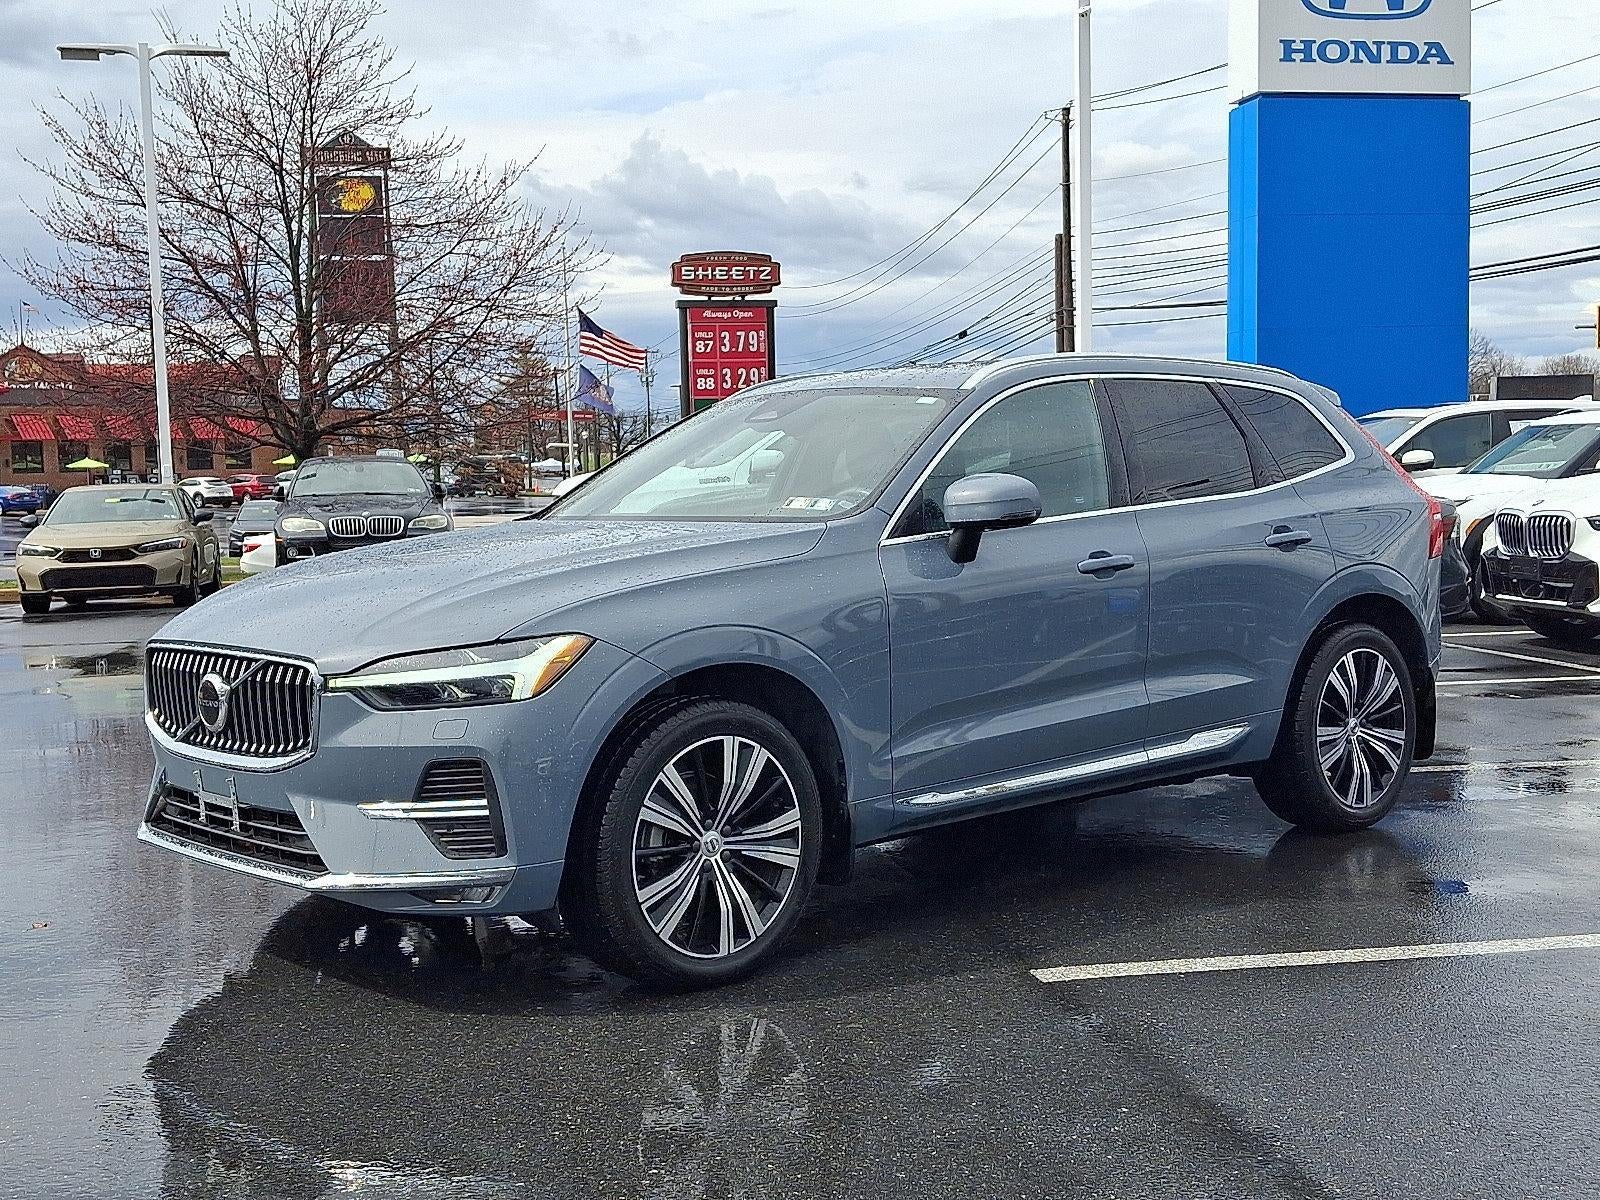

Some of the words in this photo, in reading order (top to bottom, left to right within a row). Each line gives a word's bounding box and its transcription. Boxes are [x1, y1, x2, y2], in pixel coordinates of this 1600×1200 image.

[1279, 39, 1454, 65] HONDA
[681, 266, 772, 280] SHEETZ
[703, 310, 731, 319] Always
[733, 310, 754, 319] Open
[695, 340, 714, 353] 87
[720, 330, 758, 352] 3.79
[696, 377, 715, 390] 88
